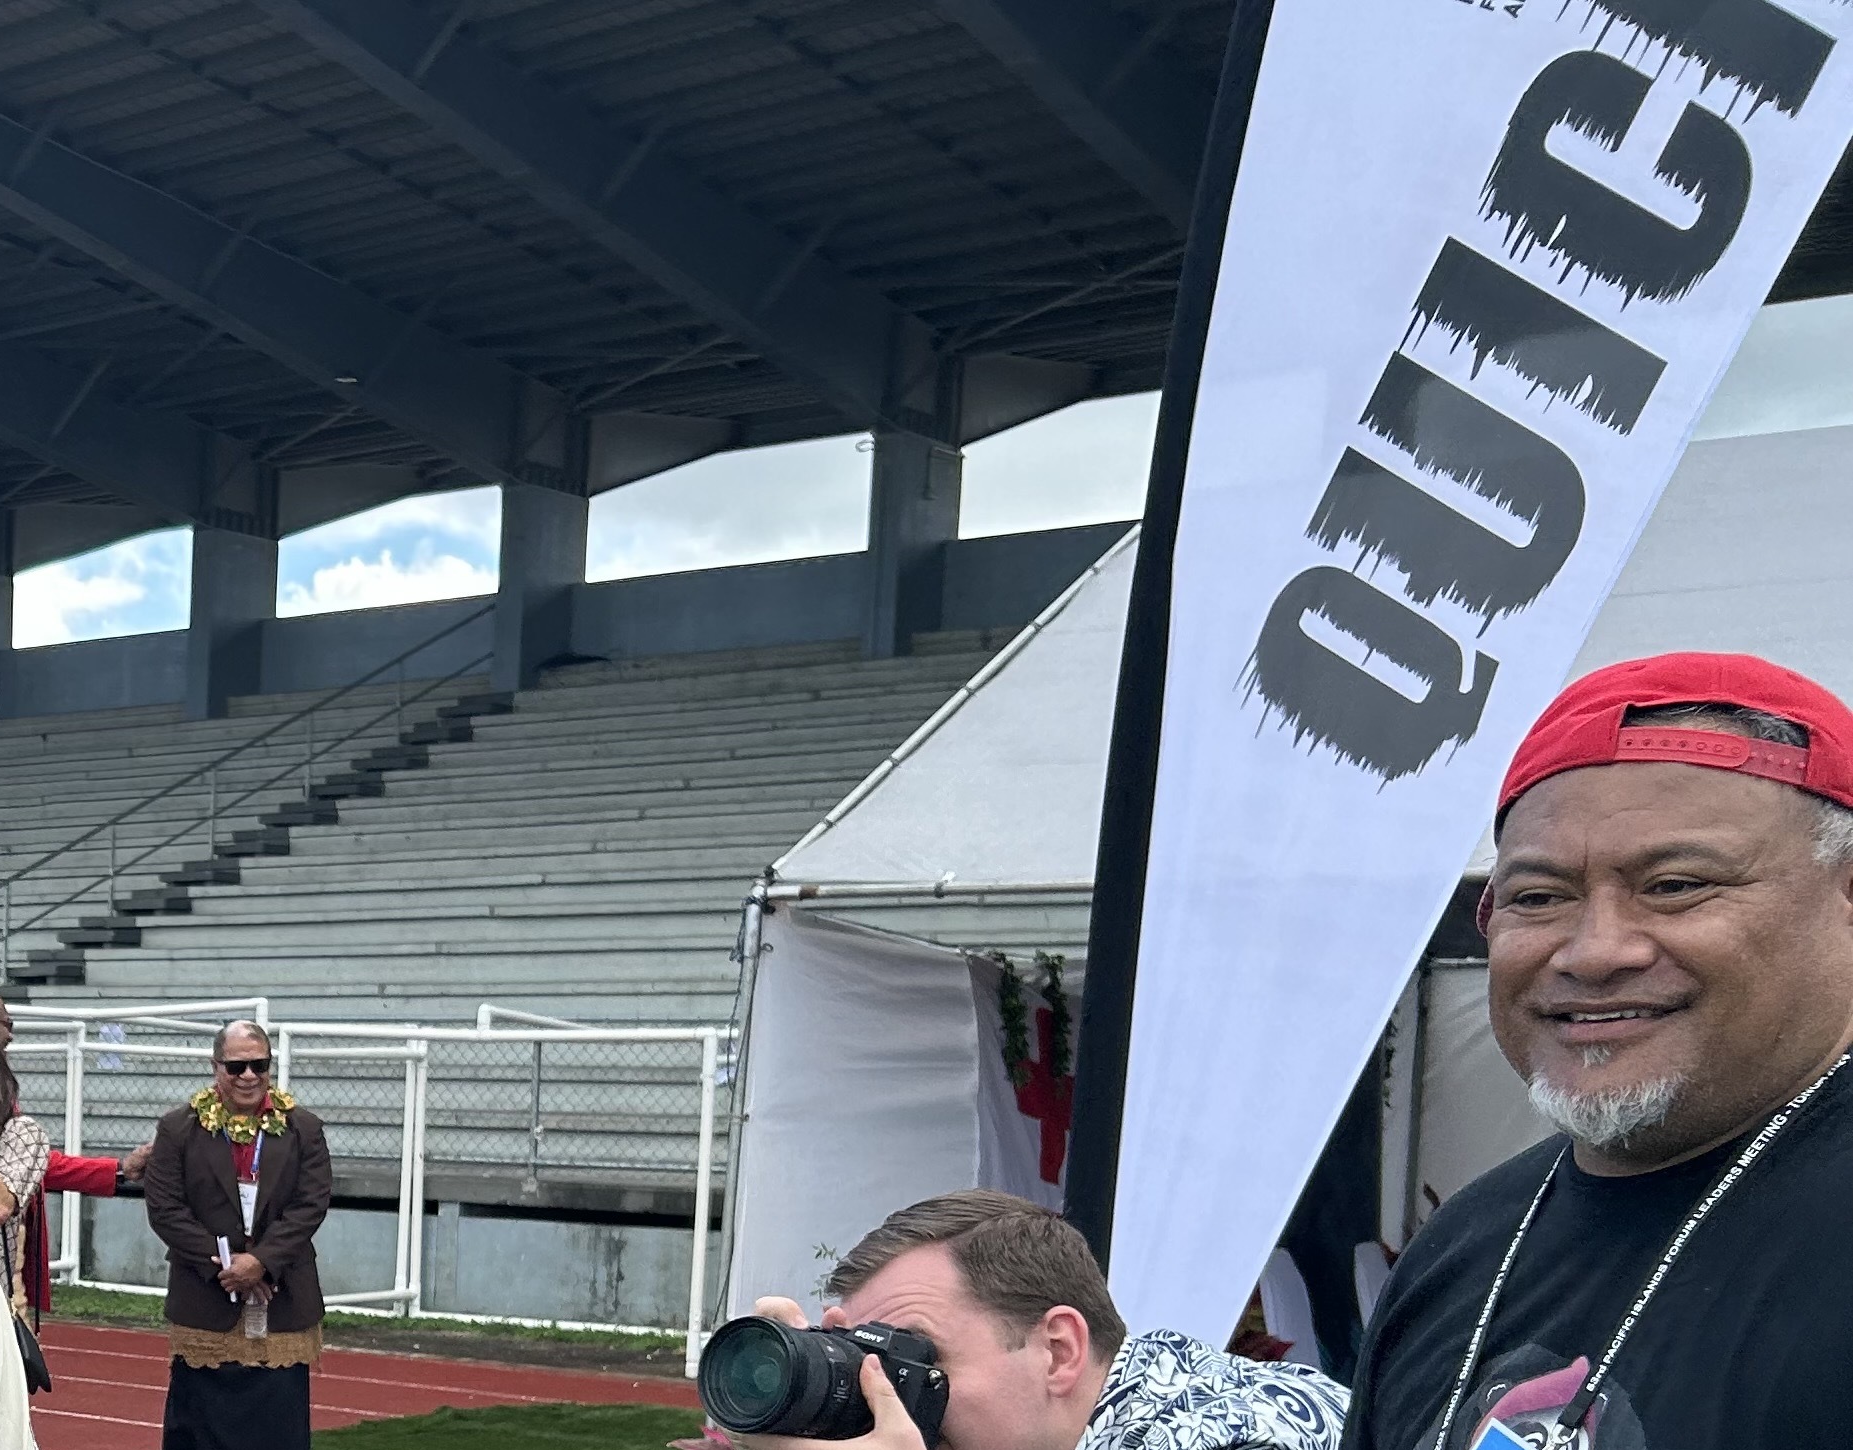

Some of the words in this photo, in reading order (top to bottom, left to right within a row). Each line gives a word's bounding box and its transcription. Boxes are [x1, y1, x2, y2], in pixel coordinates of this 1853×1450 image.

[1500, 1231, 1523, 1271] FORUM
[1603, 1316, 1635, 1364] PACIFIC
[1630, 1264, 1668, 1316] ISLANDS
[1663, 1219, 1697, 1263] FORUM
[1692, 1166, 1743, 1219] LEADERS
[1737, 1114, 1788, 1168] MEETING
[1478, 1272, 1505, 1326] LEADERS
[854, 1330, 885, 1343] SONY
[1459, 1327, 1483, 1380] MEETING
[1441, 1387, 1462, 1430] TONGA
